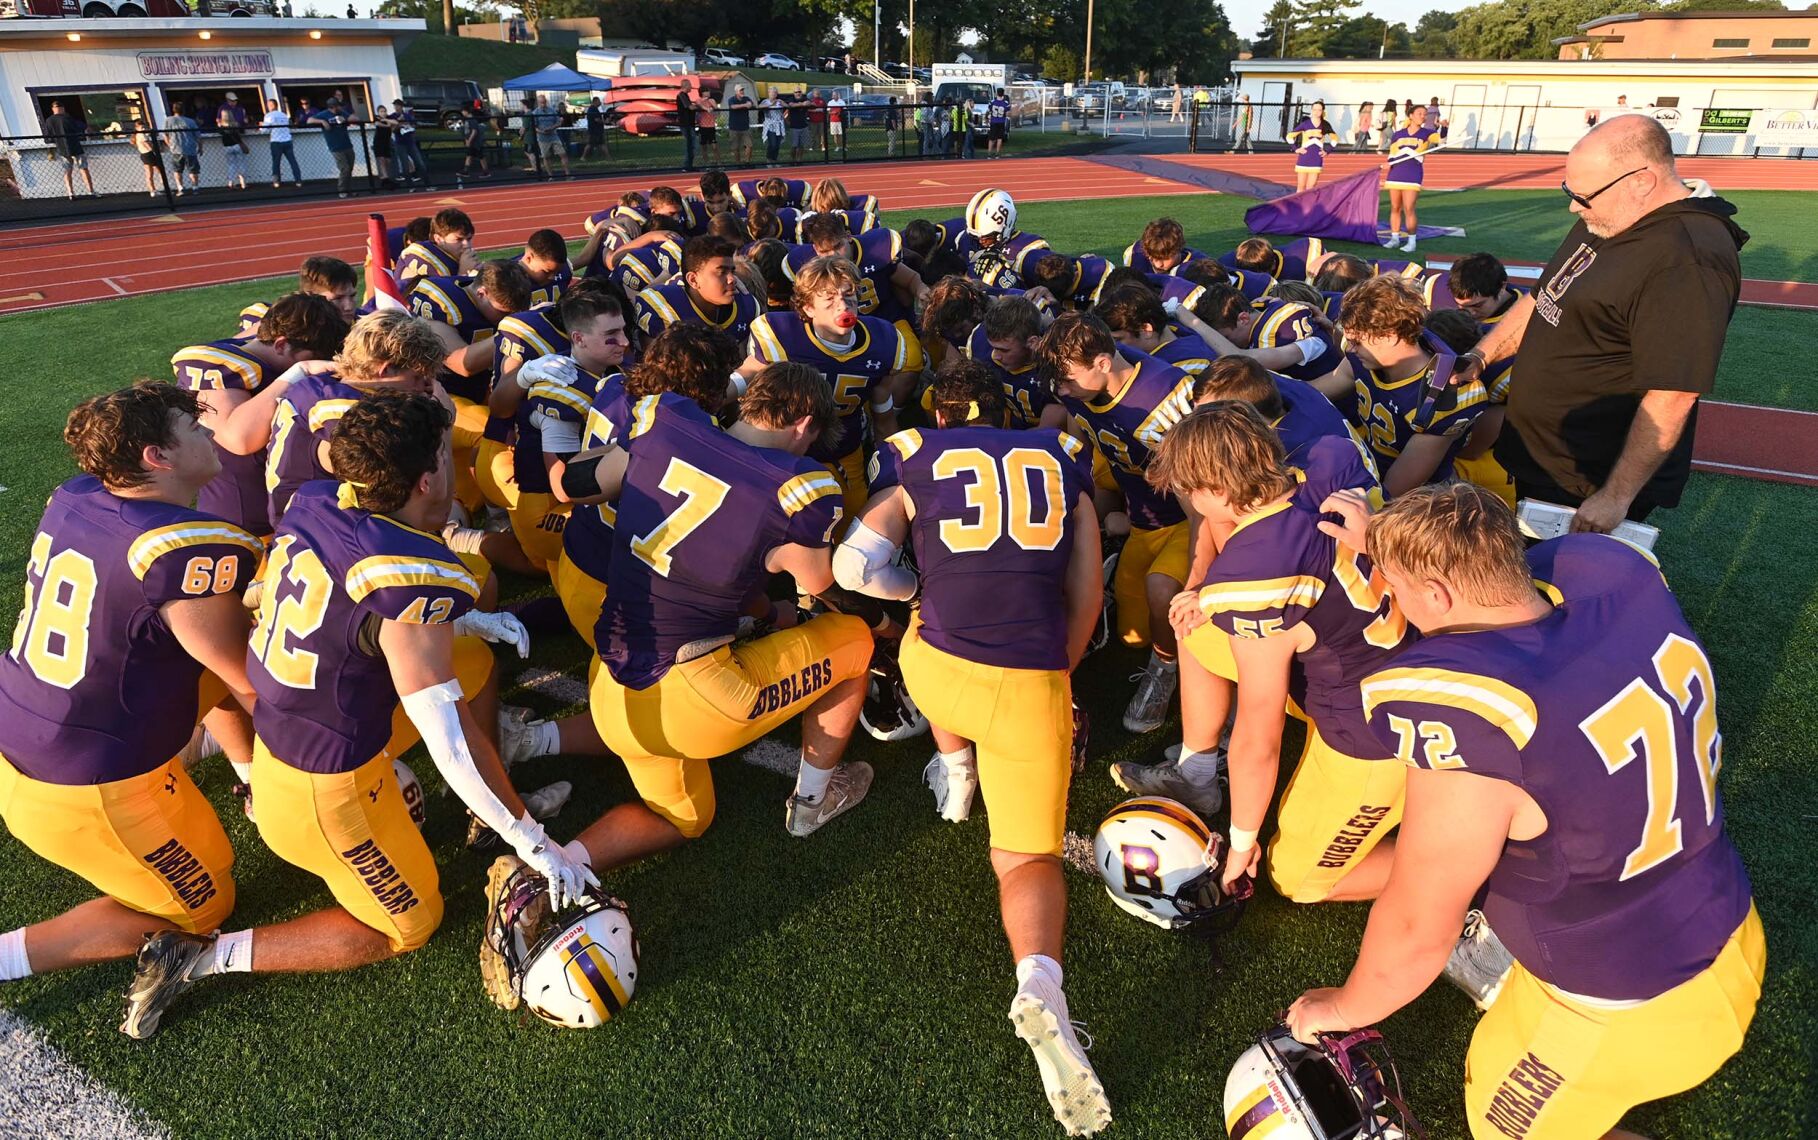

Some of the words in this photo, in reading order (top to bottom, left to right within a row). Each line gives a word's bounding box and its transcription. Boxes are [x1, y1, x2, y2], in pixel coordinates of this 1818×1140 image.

[140, 56, 187, 75] BOILING
[187, 55, 231, 75] SPRINGS
[991, 205, 1009, 226] 56
[630, 456, 732, 578] 7
[932, 447, 1067, 553] 30
[181, 555, 238, 594] 68
[396, 596, 454, 625] 42
[1232, 616, 1285, 641] 55
[1386, 712, 1468, 770] 72
[1579, 632, 1722, 881] 72
[1316, 804, 1392, 869] BUBBLERS
[143, 838, 217, 911] BUBBLERS
[341, 838, 420, 915] BUBBLERS
[1120, 842, 1163, 897] B
[1266, 1079, 1293, 1115] Riddell
[1484, 1050, 1567, 1140] BUBBLERS
